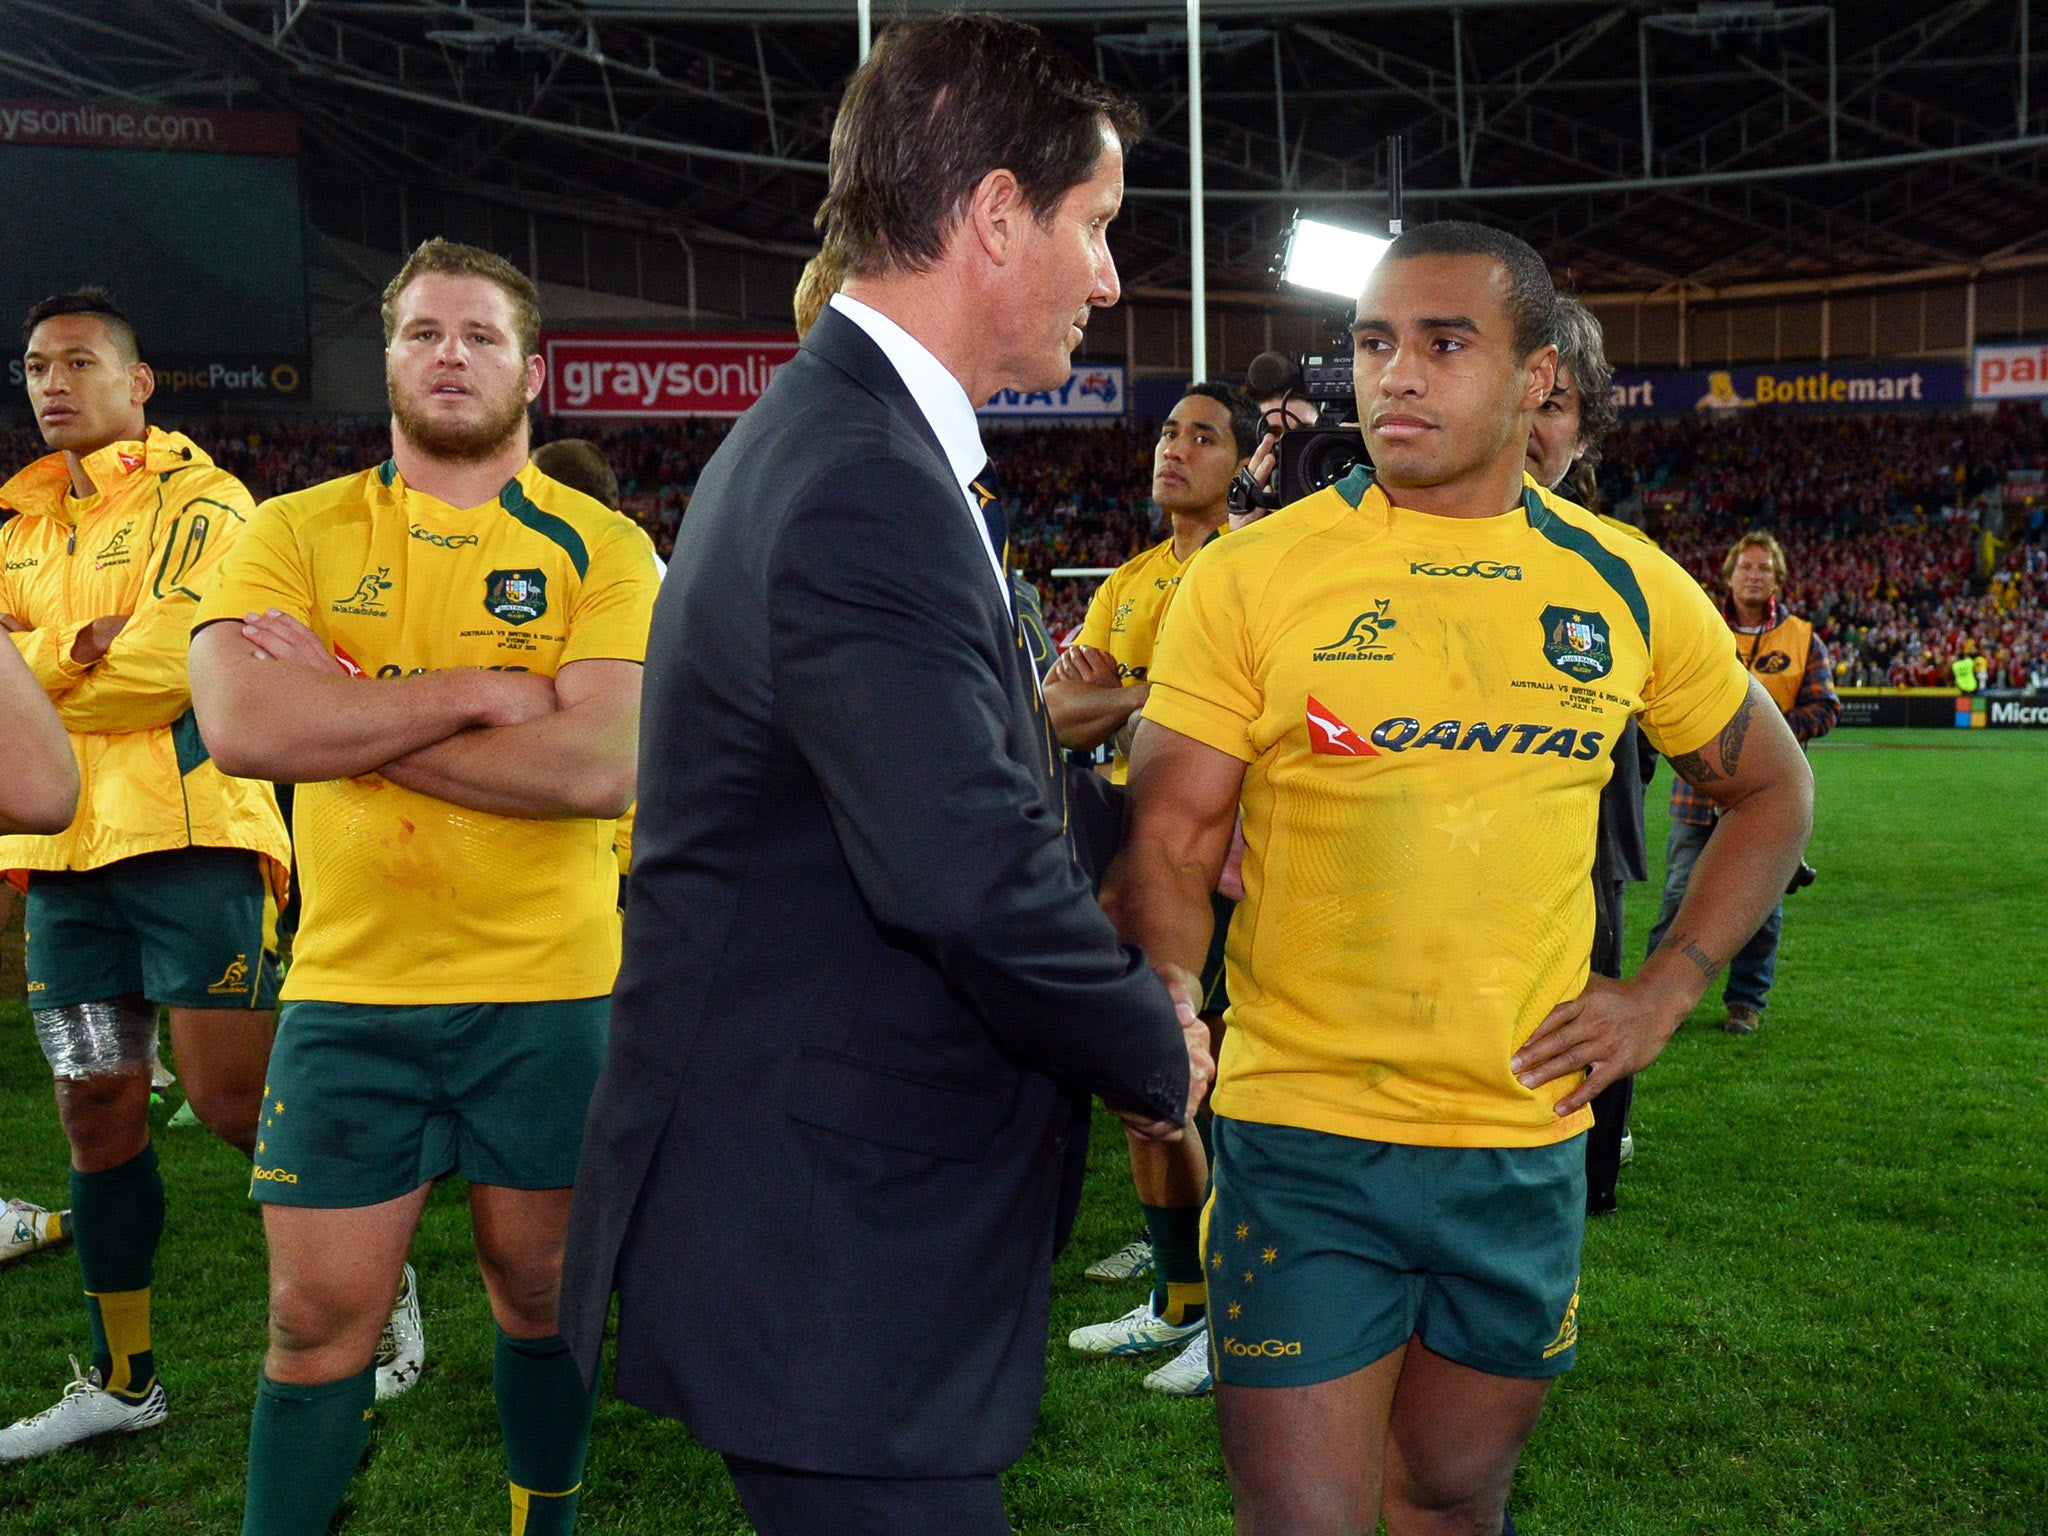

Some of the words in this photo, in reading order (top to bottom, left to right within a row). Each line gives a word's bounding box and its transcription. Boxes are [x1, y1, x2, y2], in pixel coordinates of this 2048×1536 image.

[0, 104, 215, 142] ysonline.com
[1756, 371, 1923, 402] Bottlemart
[1410, 560, 1522, 581] KooGa
[1313, 652, 1396, 662] Wallabies
[1511, 681, 1554, 690] AUSTRALIA
[1558, 684, 1569, 693] VS
[1572, 687, 1596, 697] BRITISH
[1569, 694, 1595, 705] SYDNEY
[1571, 703, 1588, 711] JULY
[1991, 701, 2048, 724] Micro
[1371, 716, 1604, 761] QANTAS
[1223, 1336, 1302, 1358] KooGa
